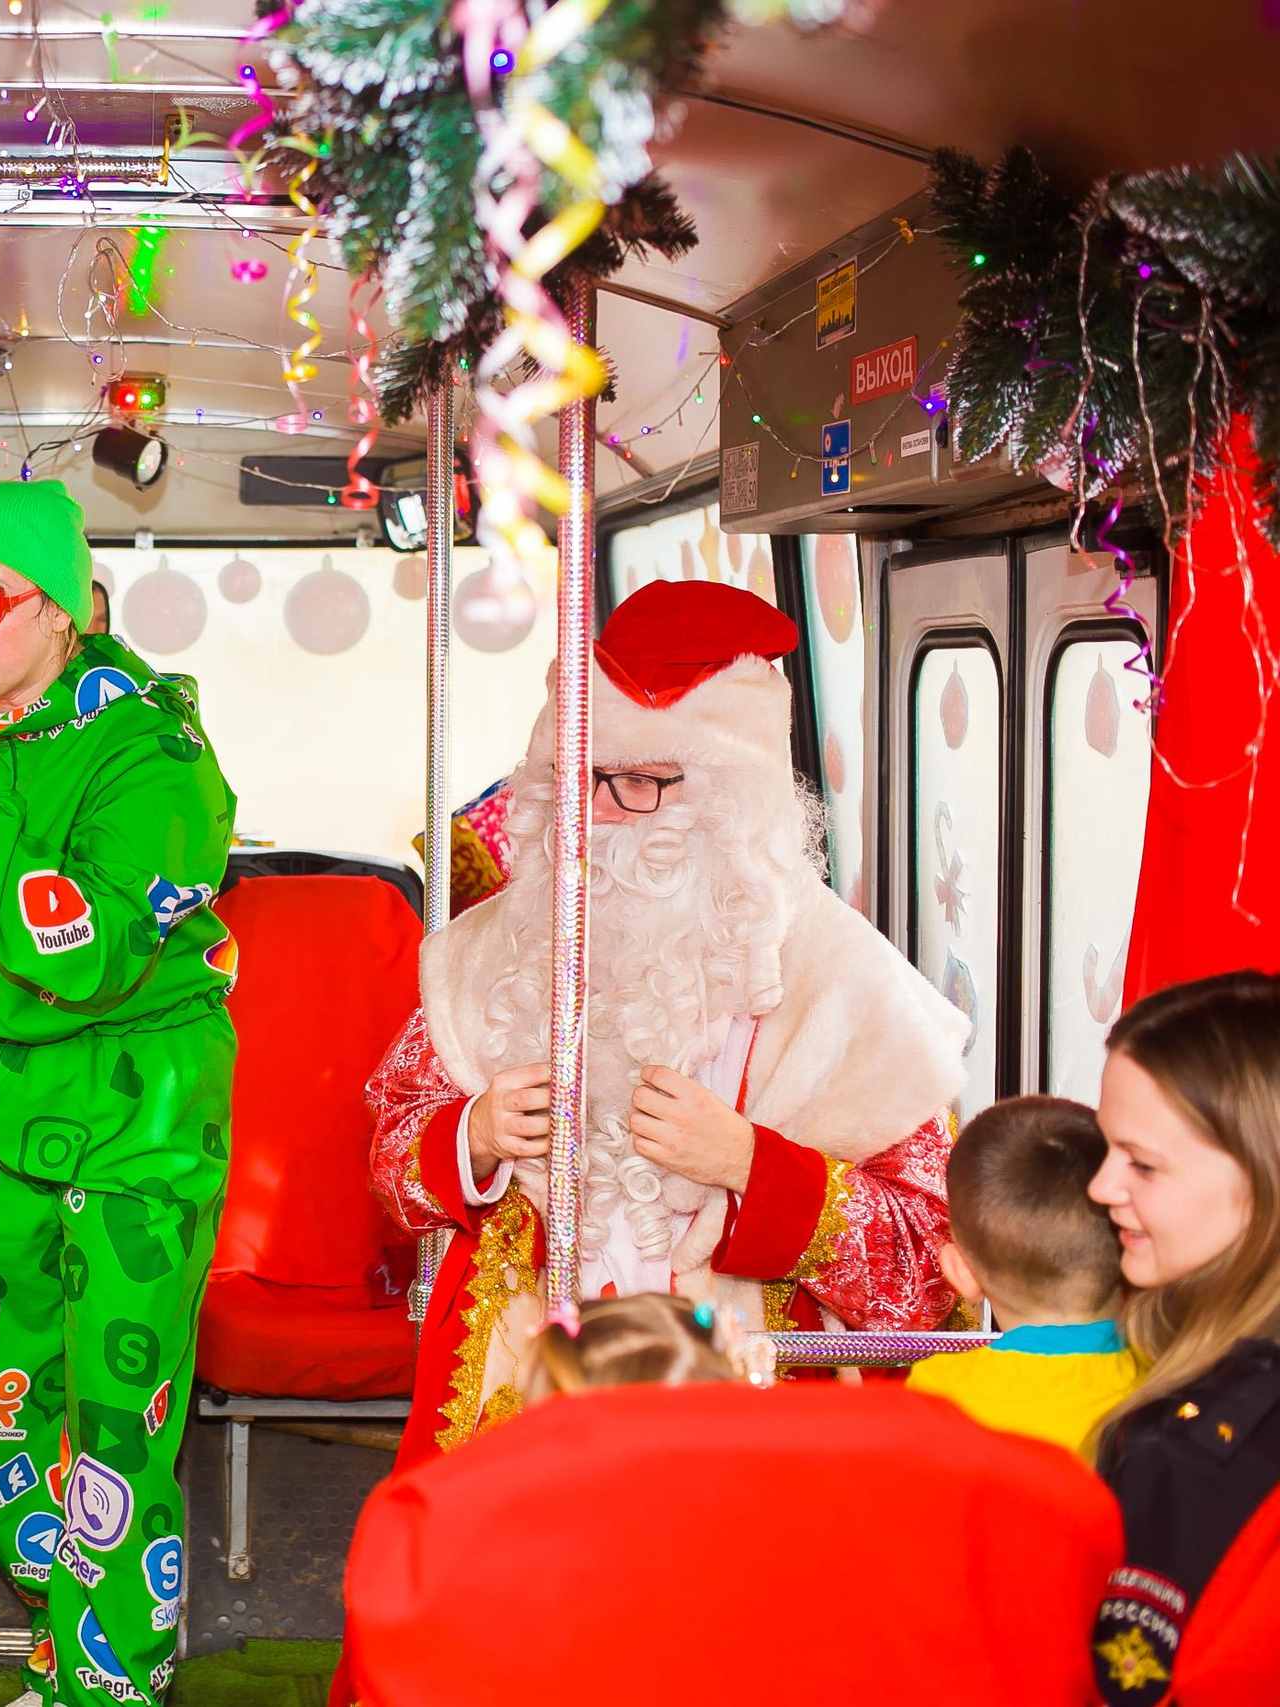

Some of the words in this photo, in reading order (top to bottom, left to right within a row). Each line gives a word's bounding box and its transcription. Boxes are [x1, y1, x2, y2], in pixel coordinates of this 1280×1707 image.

[856, 345, 913, 394] ВЫХОД
[36, 925, 91, 950] YouTube
[11, 1564, 50, 1580] Telegr
[155, 1600, 180, 1627] Sky
[78, 1670, 151, 1705] Telegra
